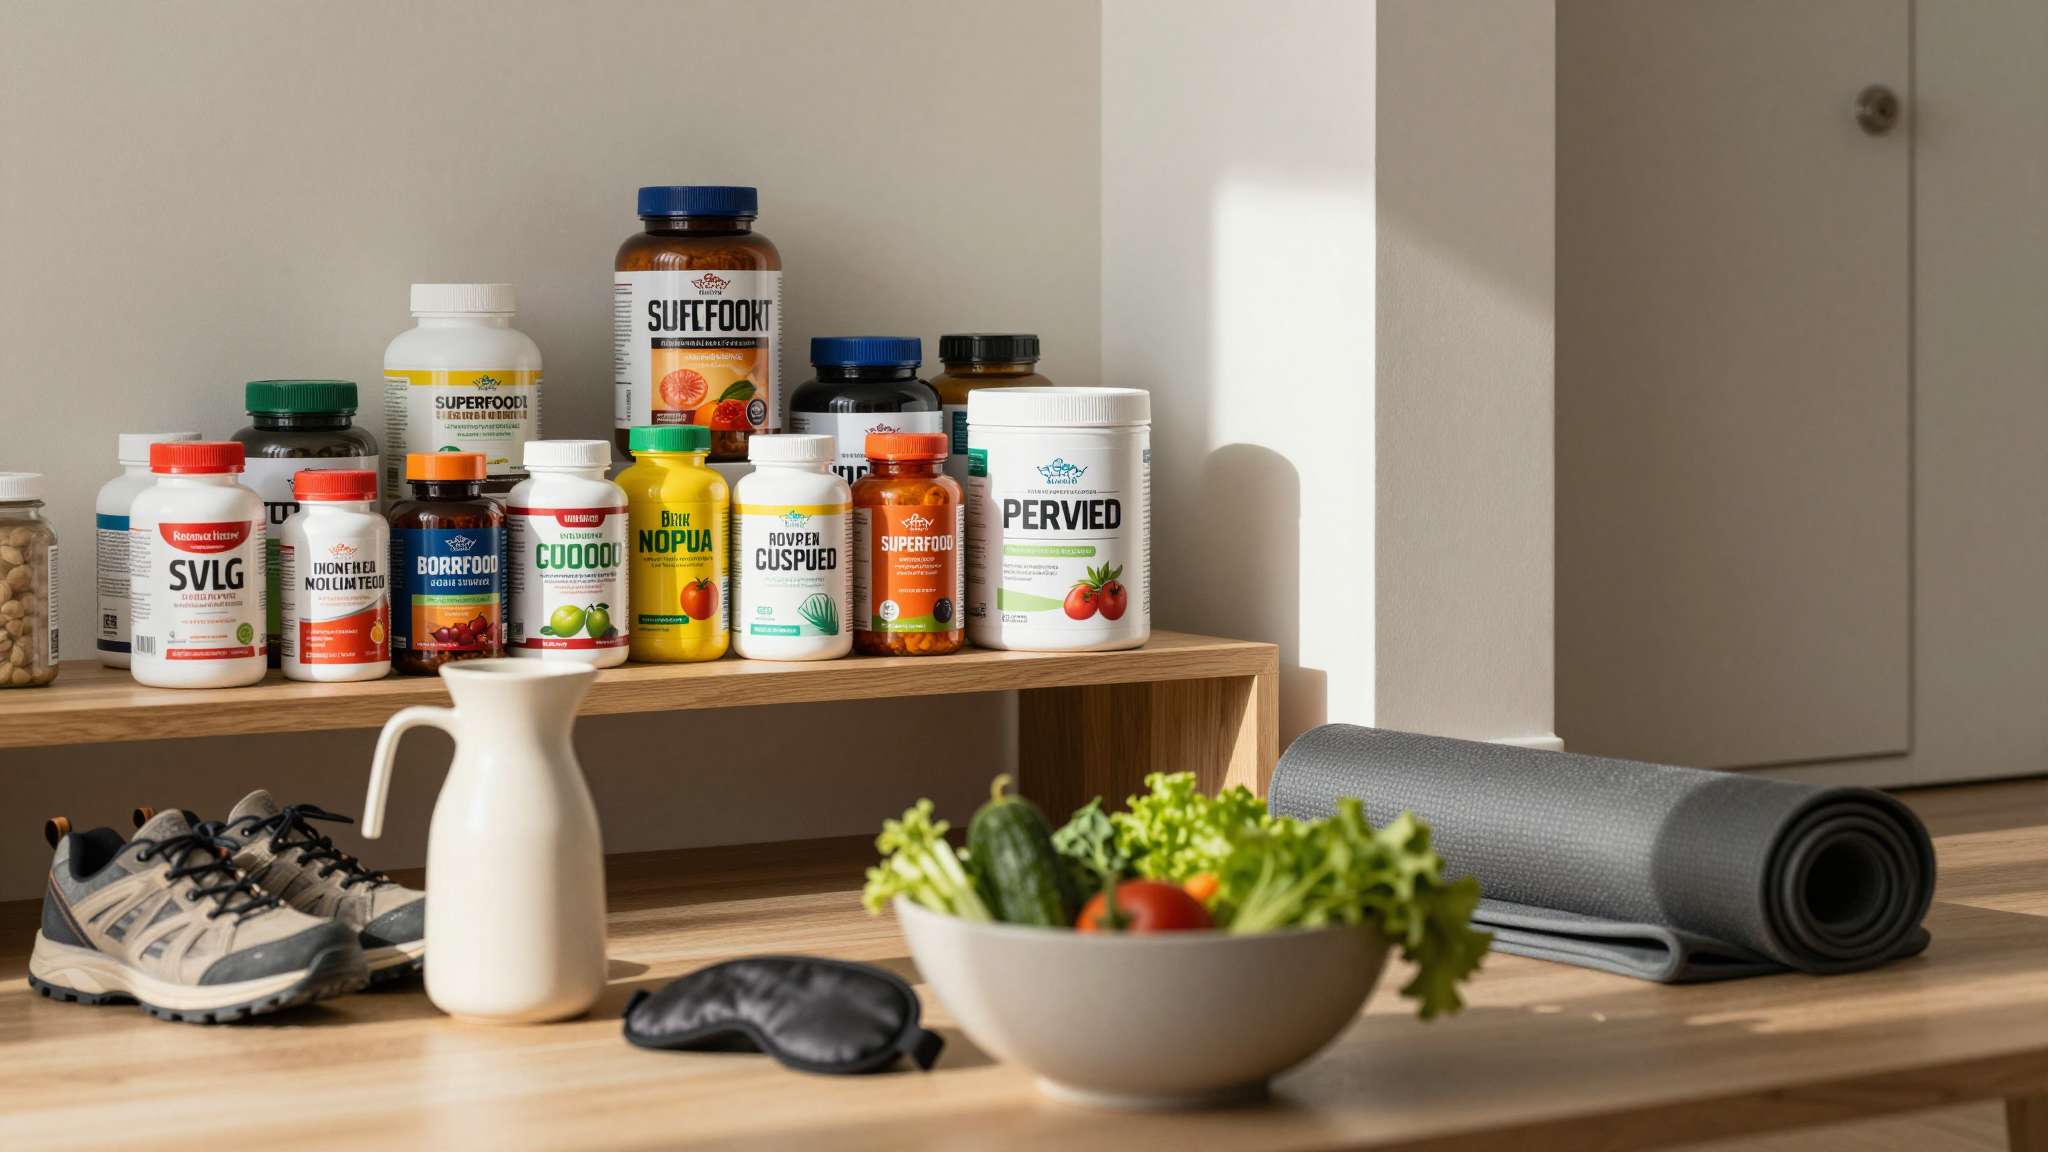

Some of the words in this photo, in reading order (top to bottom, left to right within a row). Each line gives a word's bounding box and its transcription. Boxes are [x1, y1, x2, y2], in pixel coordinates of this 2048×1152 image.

[1003, 499, 1121, 530] PERVIED
[639, 529, 713, 553] NOPUA
[881, 535, 953, 552] SUPERFOOD
[417, 555, 499, 576] BORRFOOD
[756, 548, 837, 571] CUSPUED
[169, 558, 244, 591] SVLG
